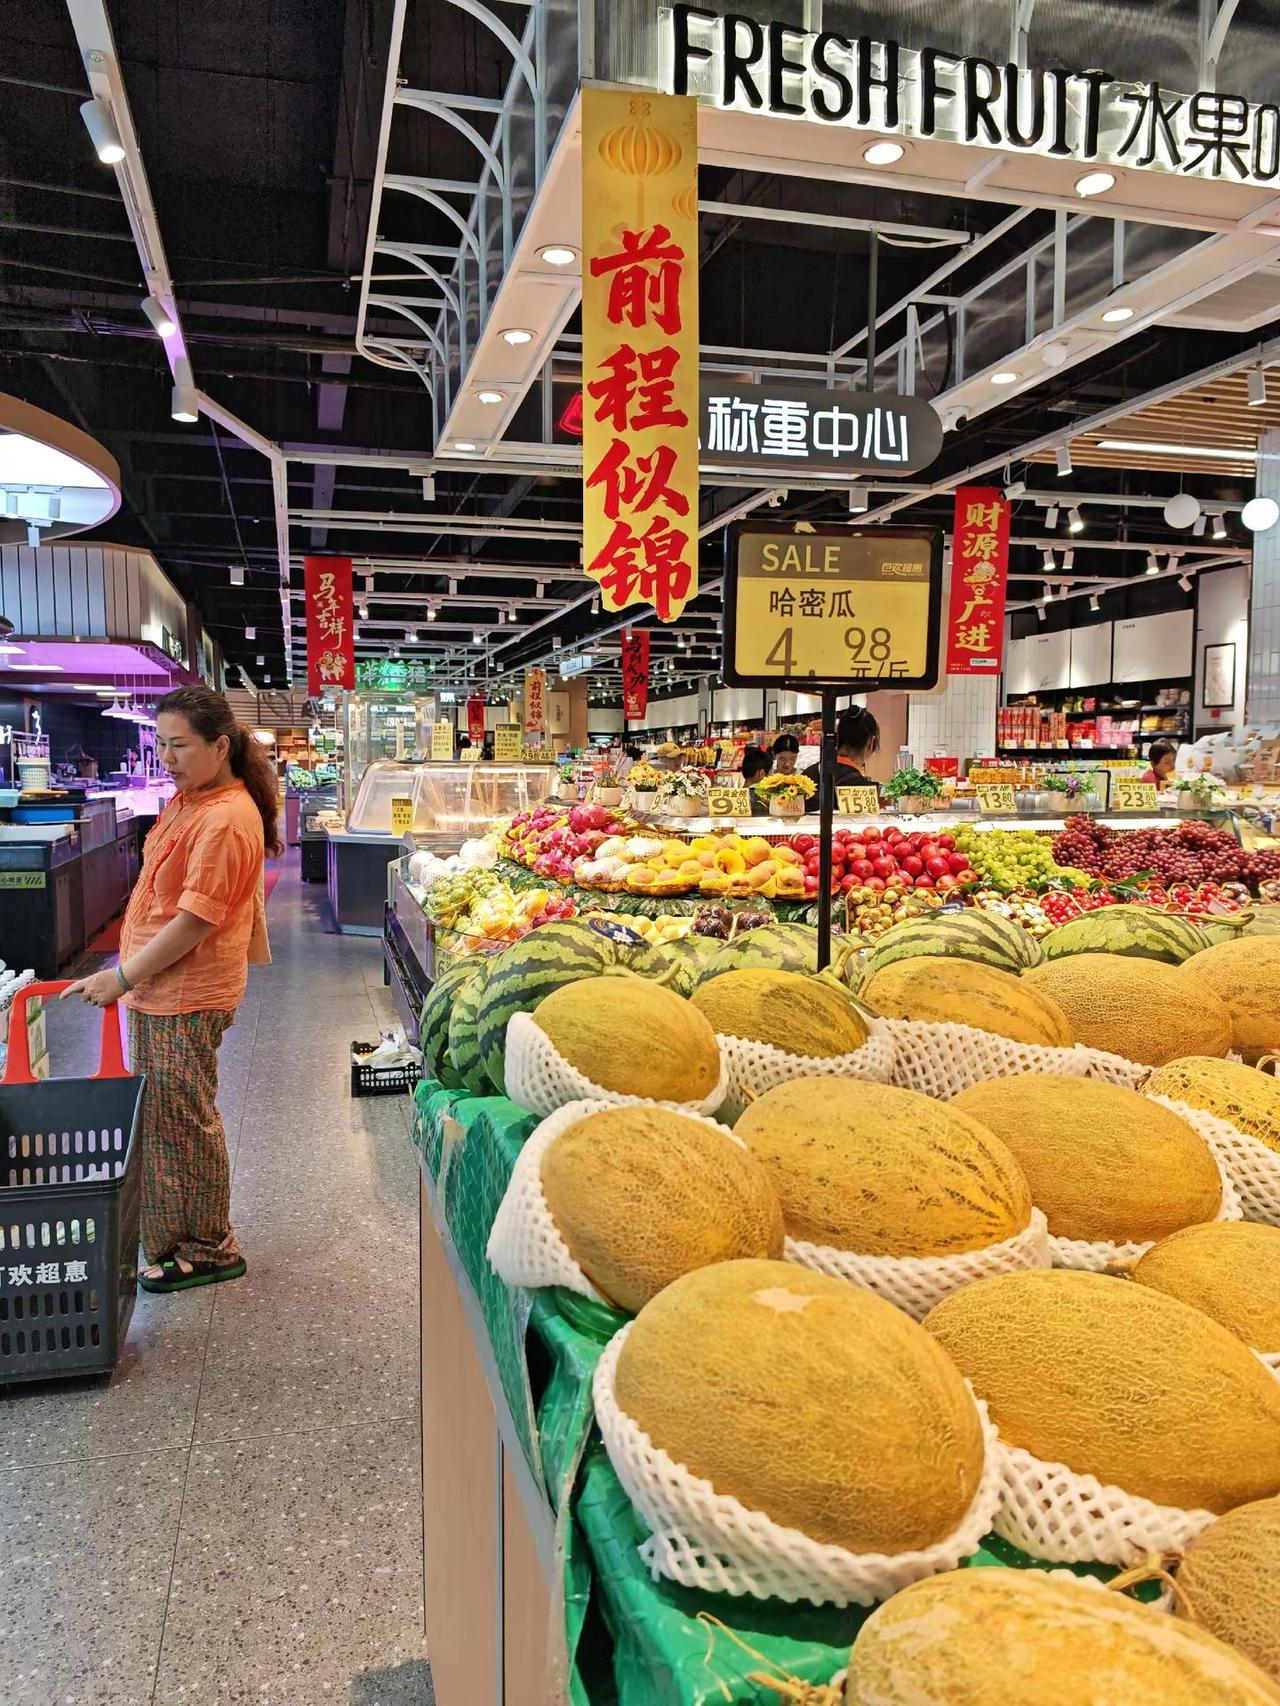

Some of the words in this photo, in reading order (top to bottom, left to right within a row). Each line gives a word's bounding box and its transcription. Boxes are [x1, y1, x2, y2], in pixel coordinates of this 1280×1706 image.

[672, 3, 899, 127] FRESH
[920, 46, 1115, 158] FRUIT
[586, 223, 691, 620] 前程似锦
[697, 394, 910, 463] 称重中心
[761, 543, 841, 573] SALE
[769, 587, 856, 619] 哈密瓜
[954, 501, 1004, 652] 财源广进
